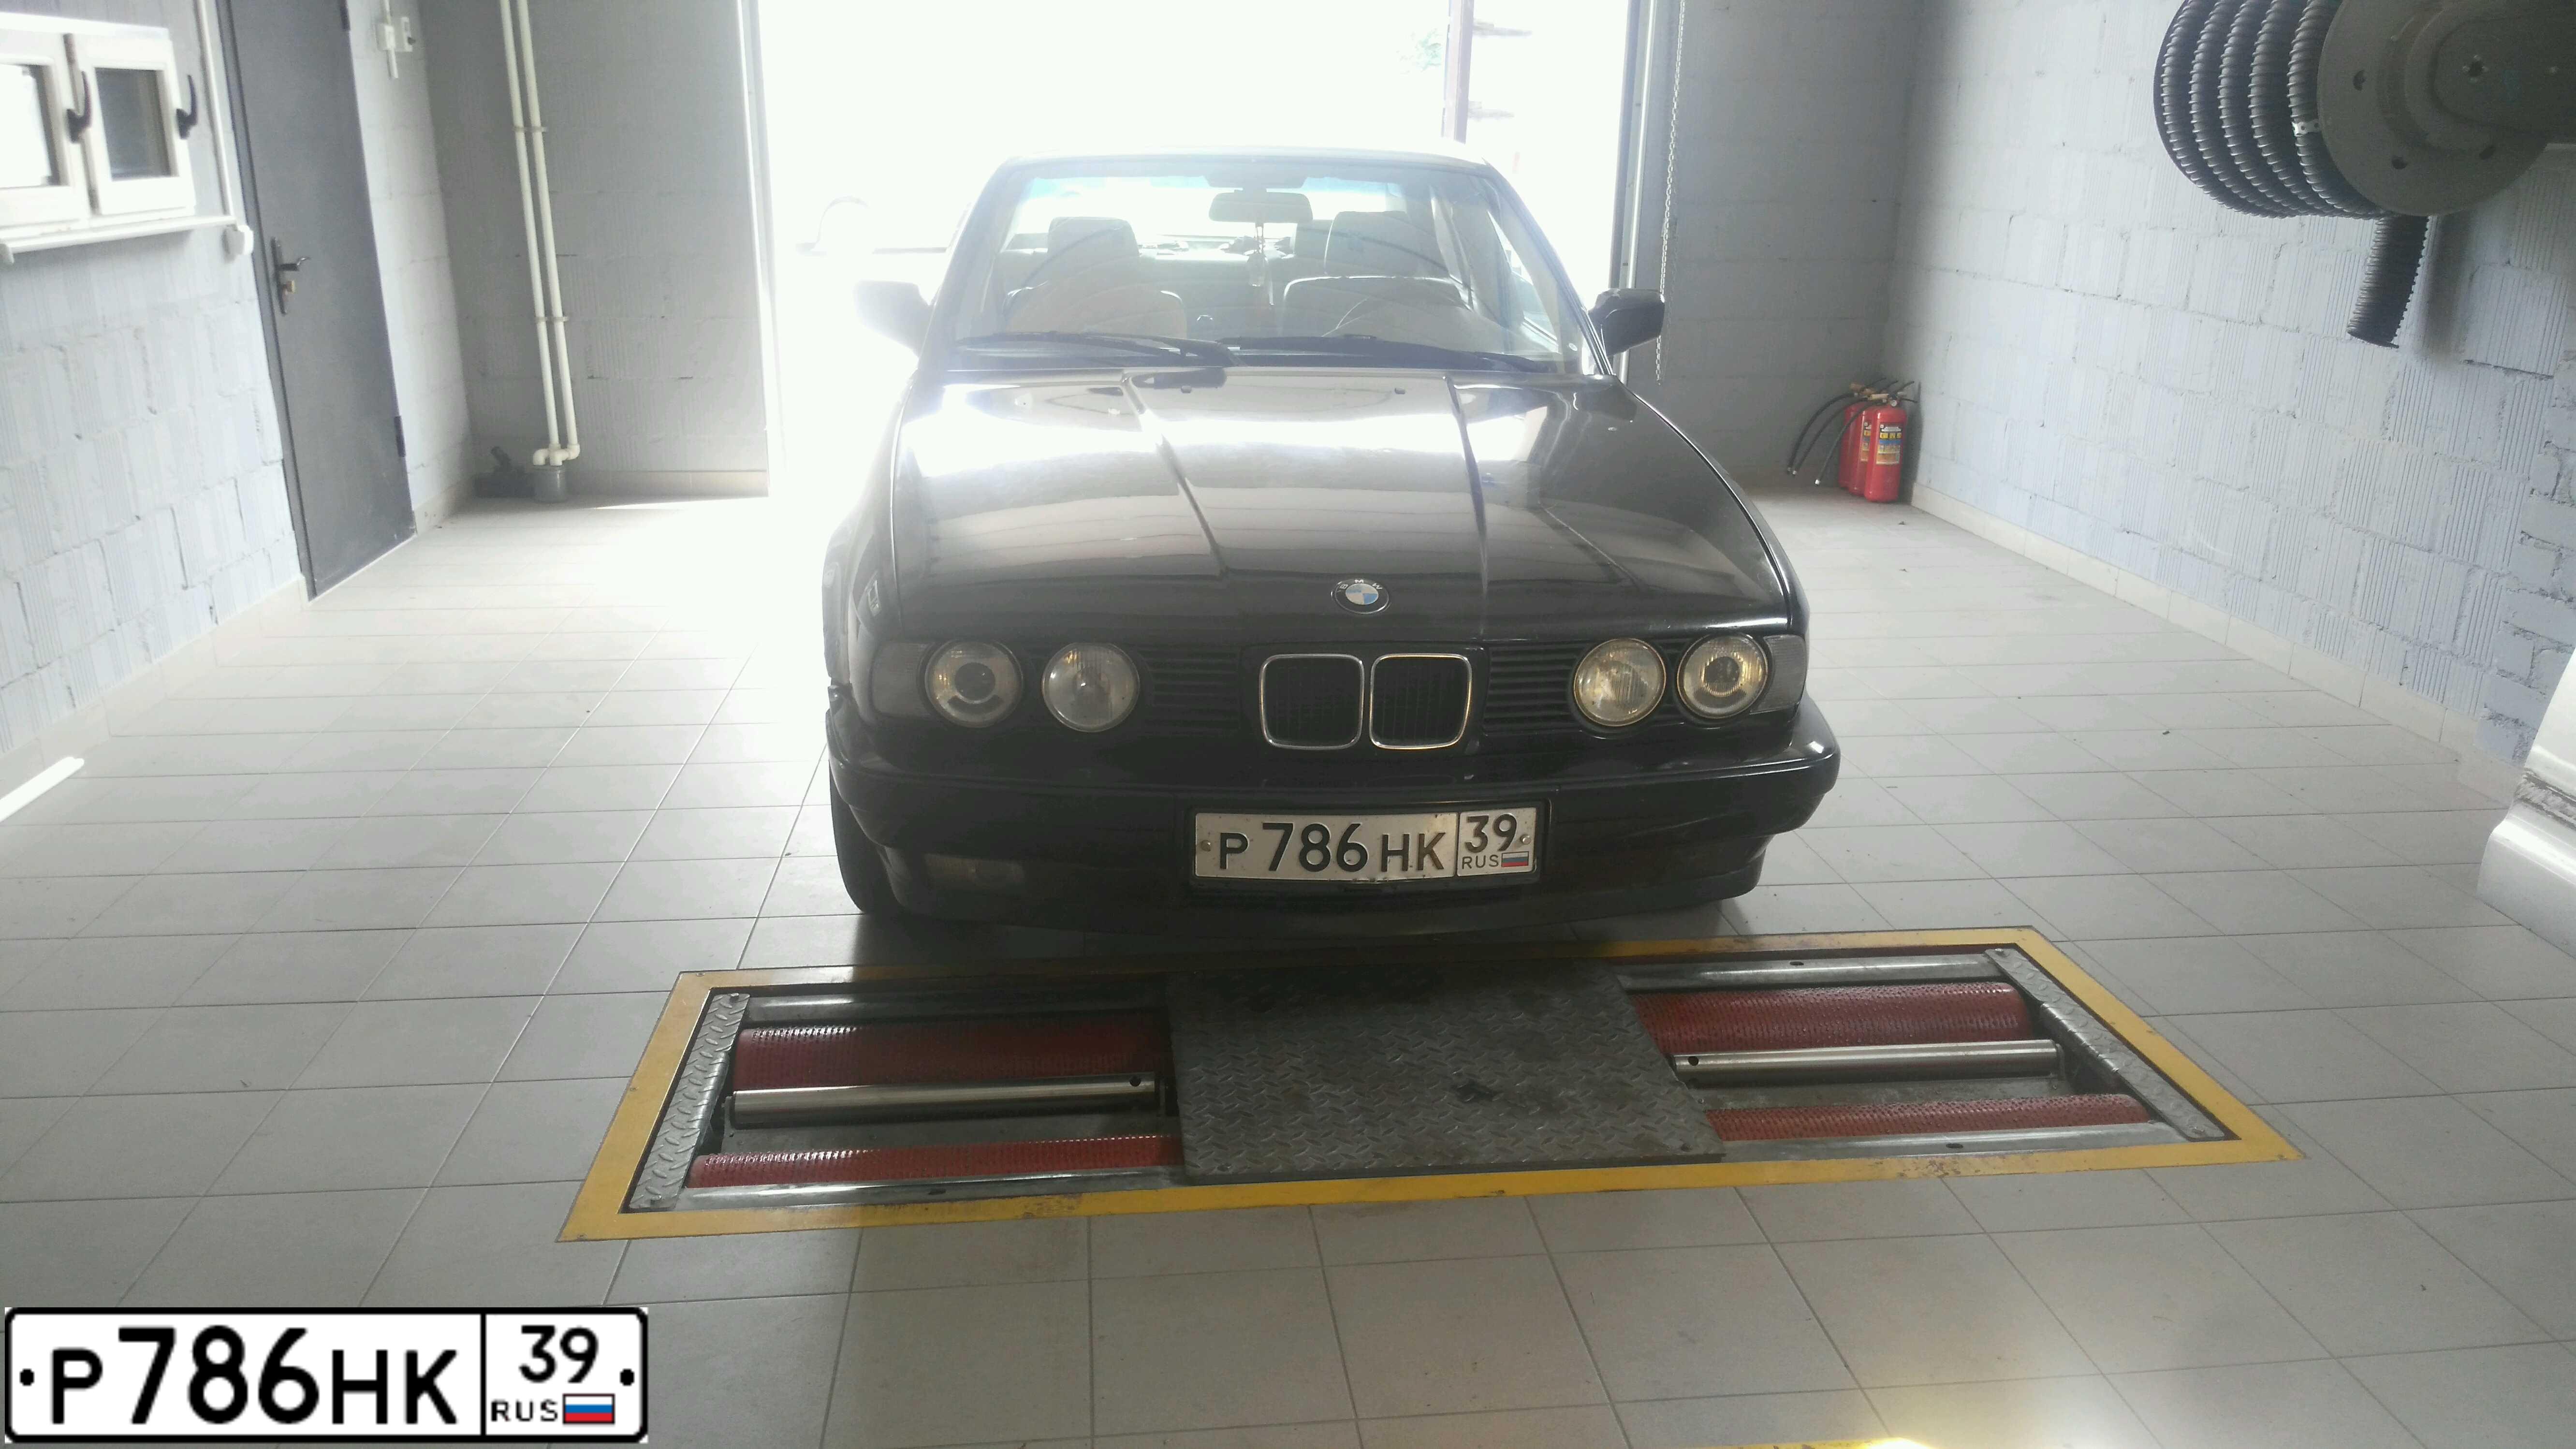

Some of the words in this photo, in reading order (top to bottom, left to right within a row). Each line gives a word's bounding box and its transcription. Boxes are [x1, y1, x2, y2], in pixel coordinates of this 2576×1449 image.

[1340, 579, 1383, 590] BMW
[1465, 814, 1517, 853] 39
[1462, 854, 1499, 869] RUS
